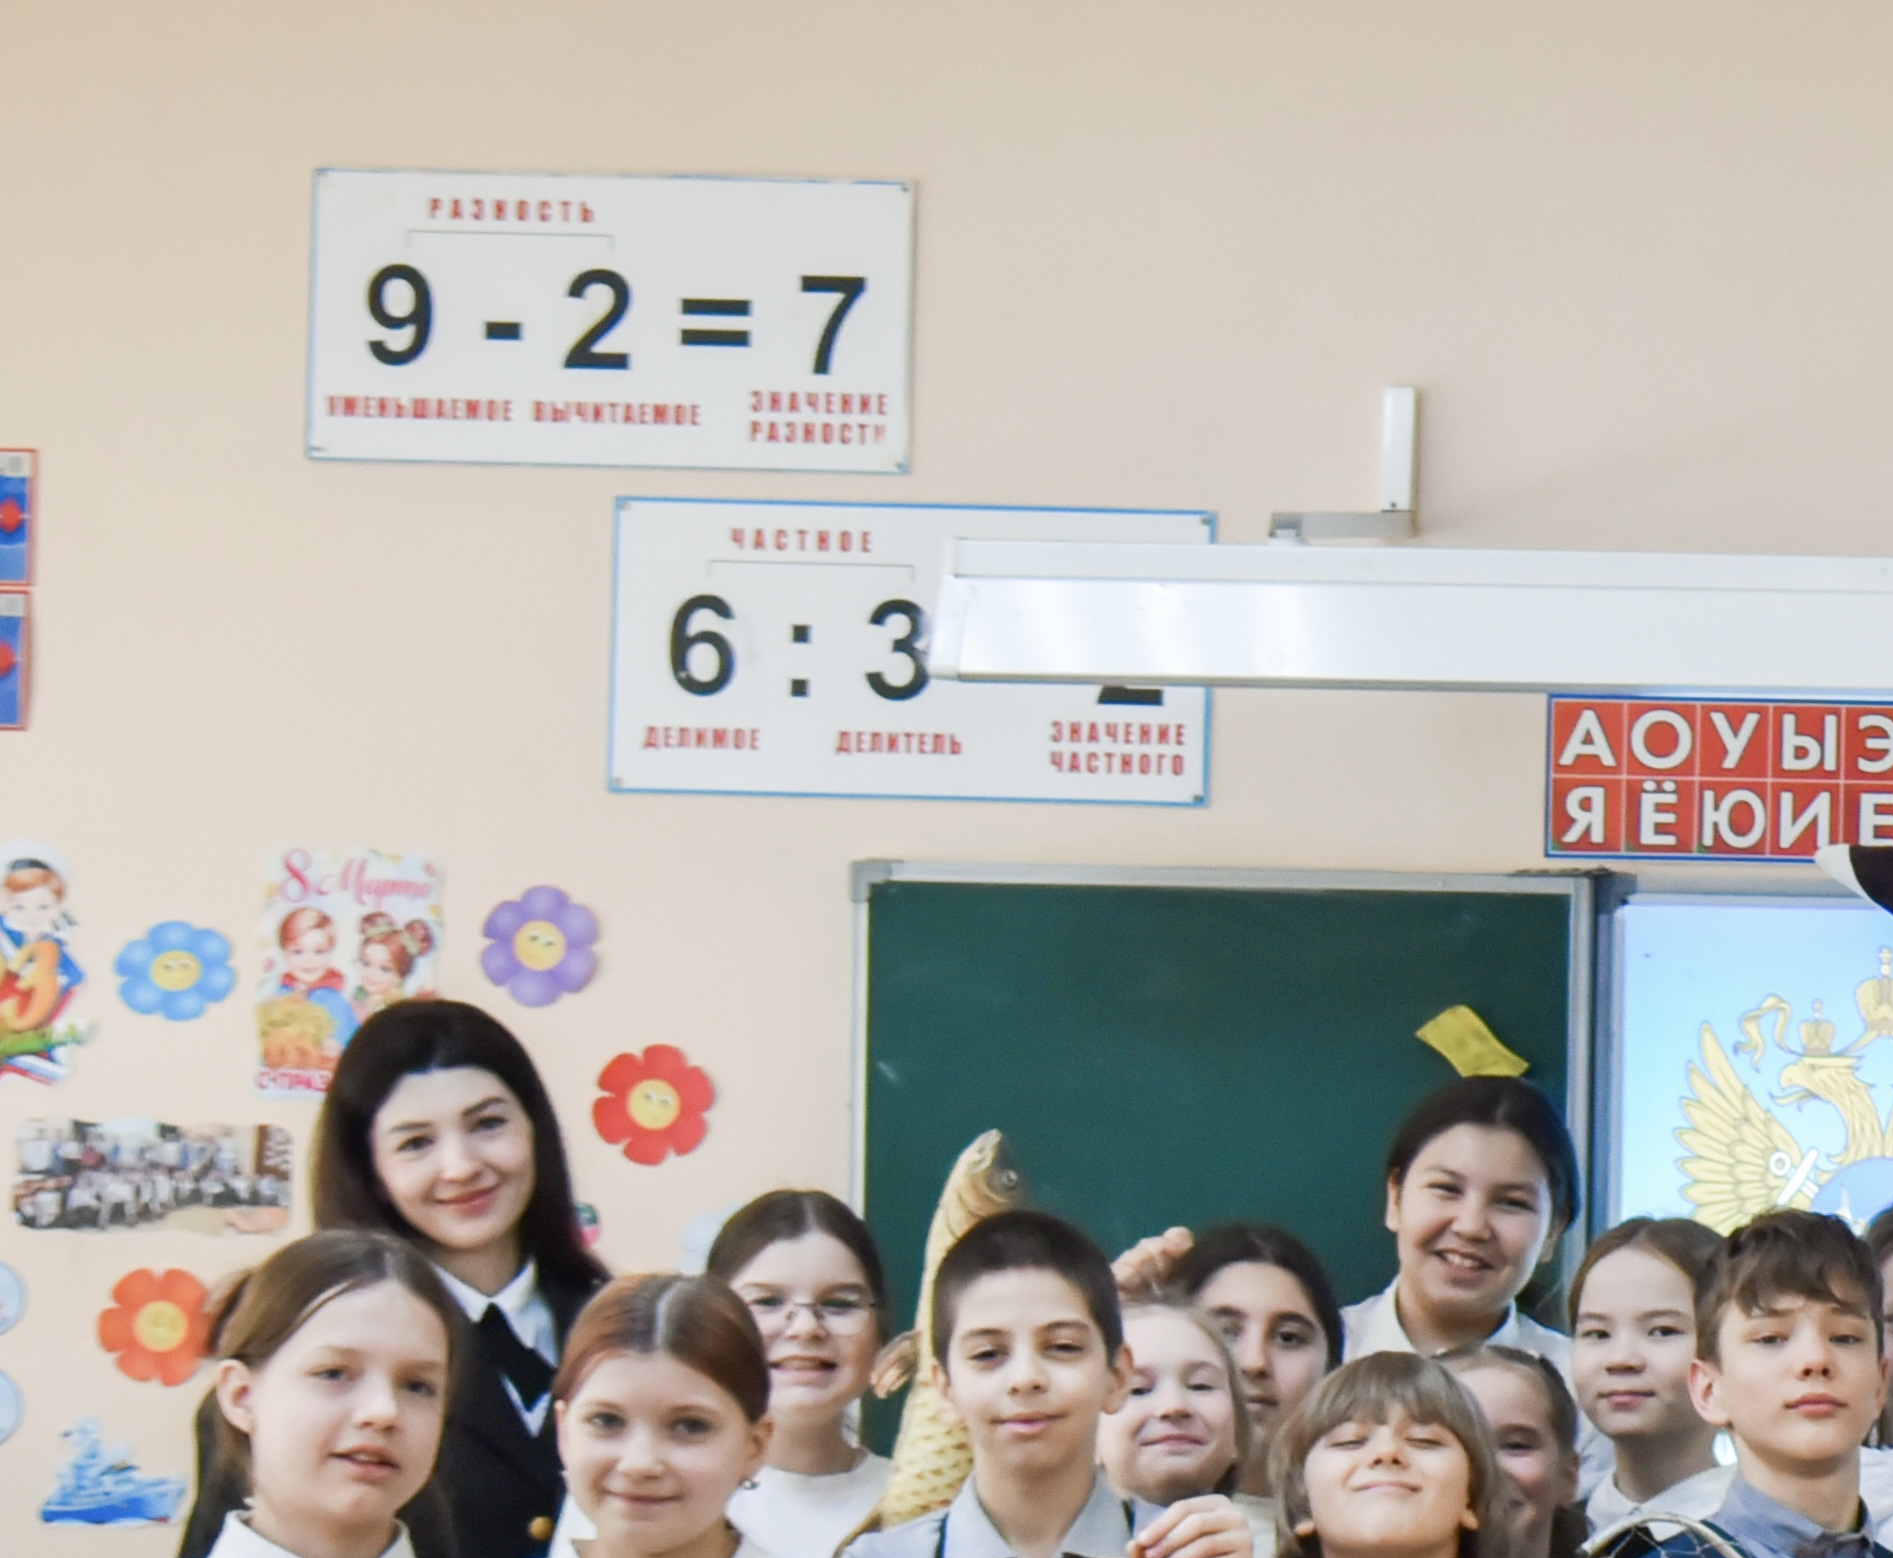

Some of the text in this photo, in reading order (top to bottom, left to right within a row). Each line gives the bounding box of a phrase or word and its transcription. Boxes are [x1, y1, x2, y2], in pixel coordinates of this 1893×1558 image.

[429, 198, 596, 222] РАЗНОСТЬ
[366, 263, 433, 366] 9
[562, 269, 632, 370] 2
[801, 275, 867, 375] 7
[327, 396, 702, 427] УМЕНЬШАЕМОЕ ВЫЧИТАЕМОЕ
[750, 391, 889, 416] ЗНАЧЕНИЕ
[750, 422, 888, 446] РАЗНОСТИ
[731, 528, 873, 553] ЧАСТНОЕ
[669, 594, 737, 697] 6
[865, 599, 931, 702] 3
[644, 726, 964, 756] ДЕЛИМОЕ ДЕЛИТЕЛЬ
[1050, 721, 1187, 746] ЗНАЧЕНИЕ
[1050, 752, 1185, 777] ЧАСТНОГО
